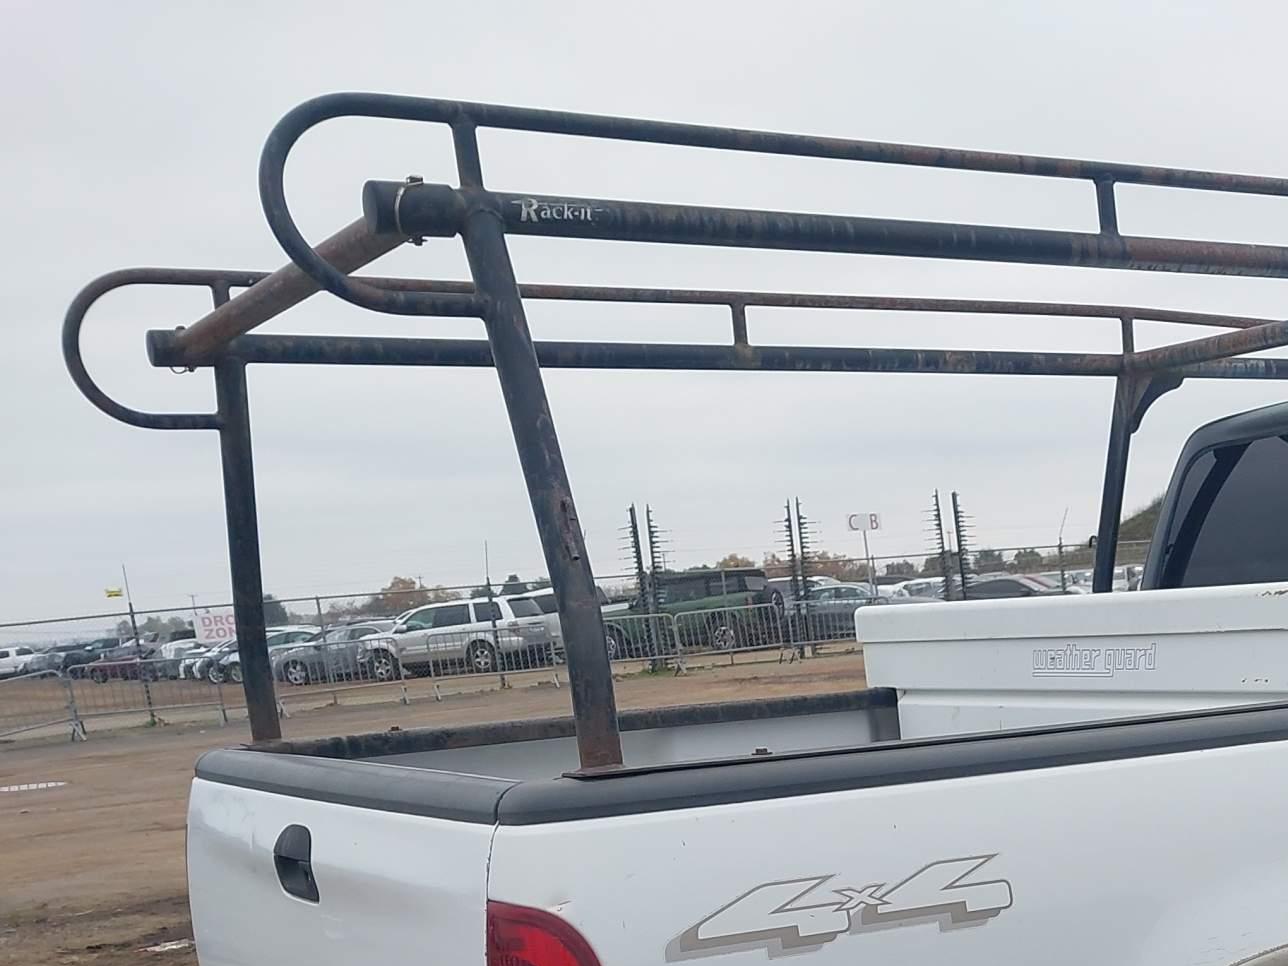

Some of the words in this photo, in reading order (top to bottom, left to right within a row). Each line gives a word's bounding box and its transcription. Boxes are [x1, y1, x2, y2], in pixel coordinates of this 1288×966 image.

[848, 514, 859, 530] C
[869, 513, 879, 530] B
[1032, 644, 1101, 671] weather
[1103, 643, 1157, 677] guard
